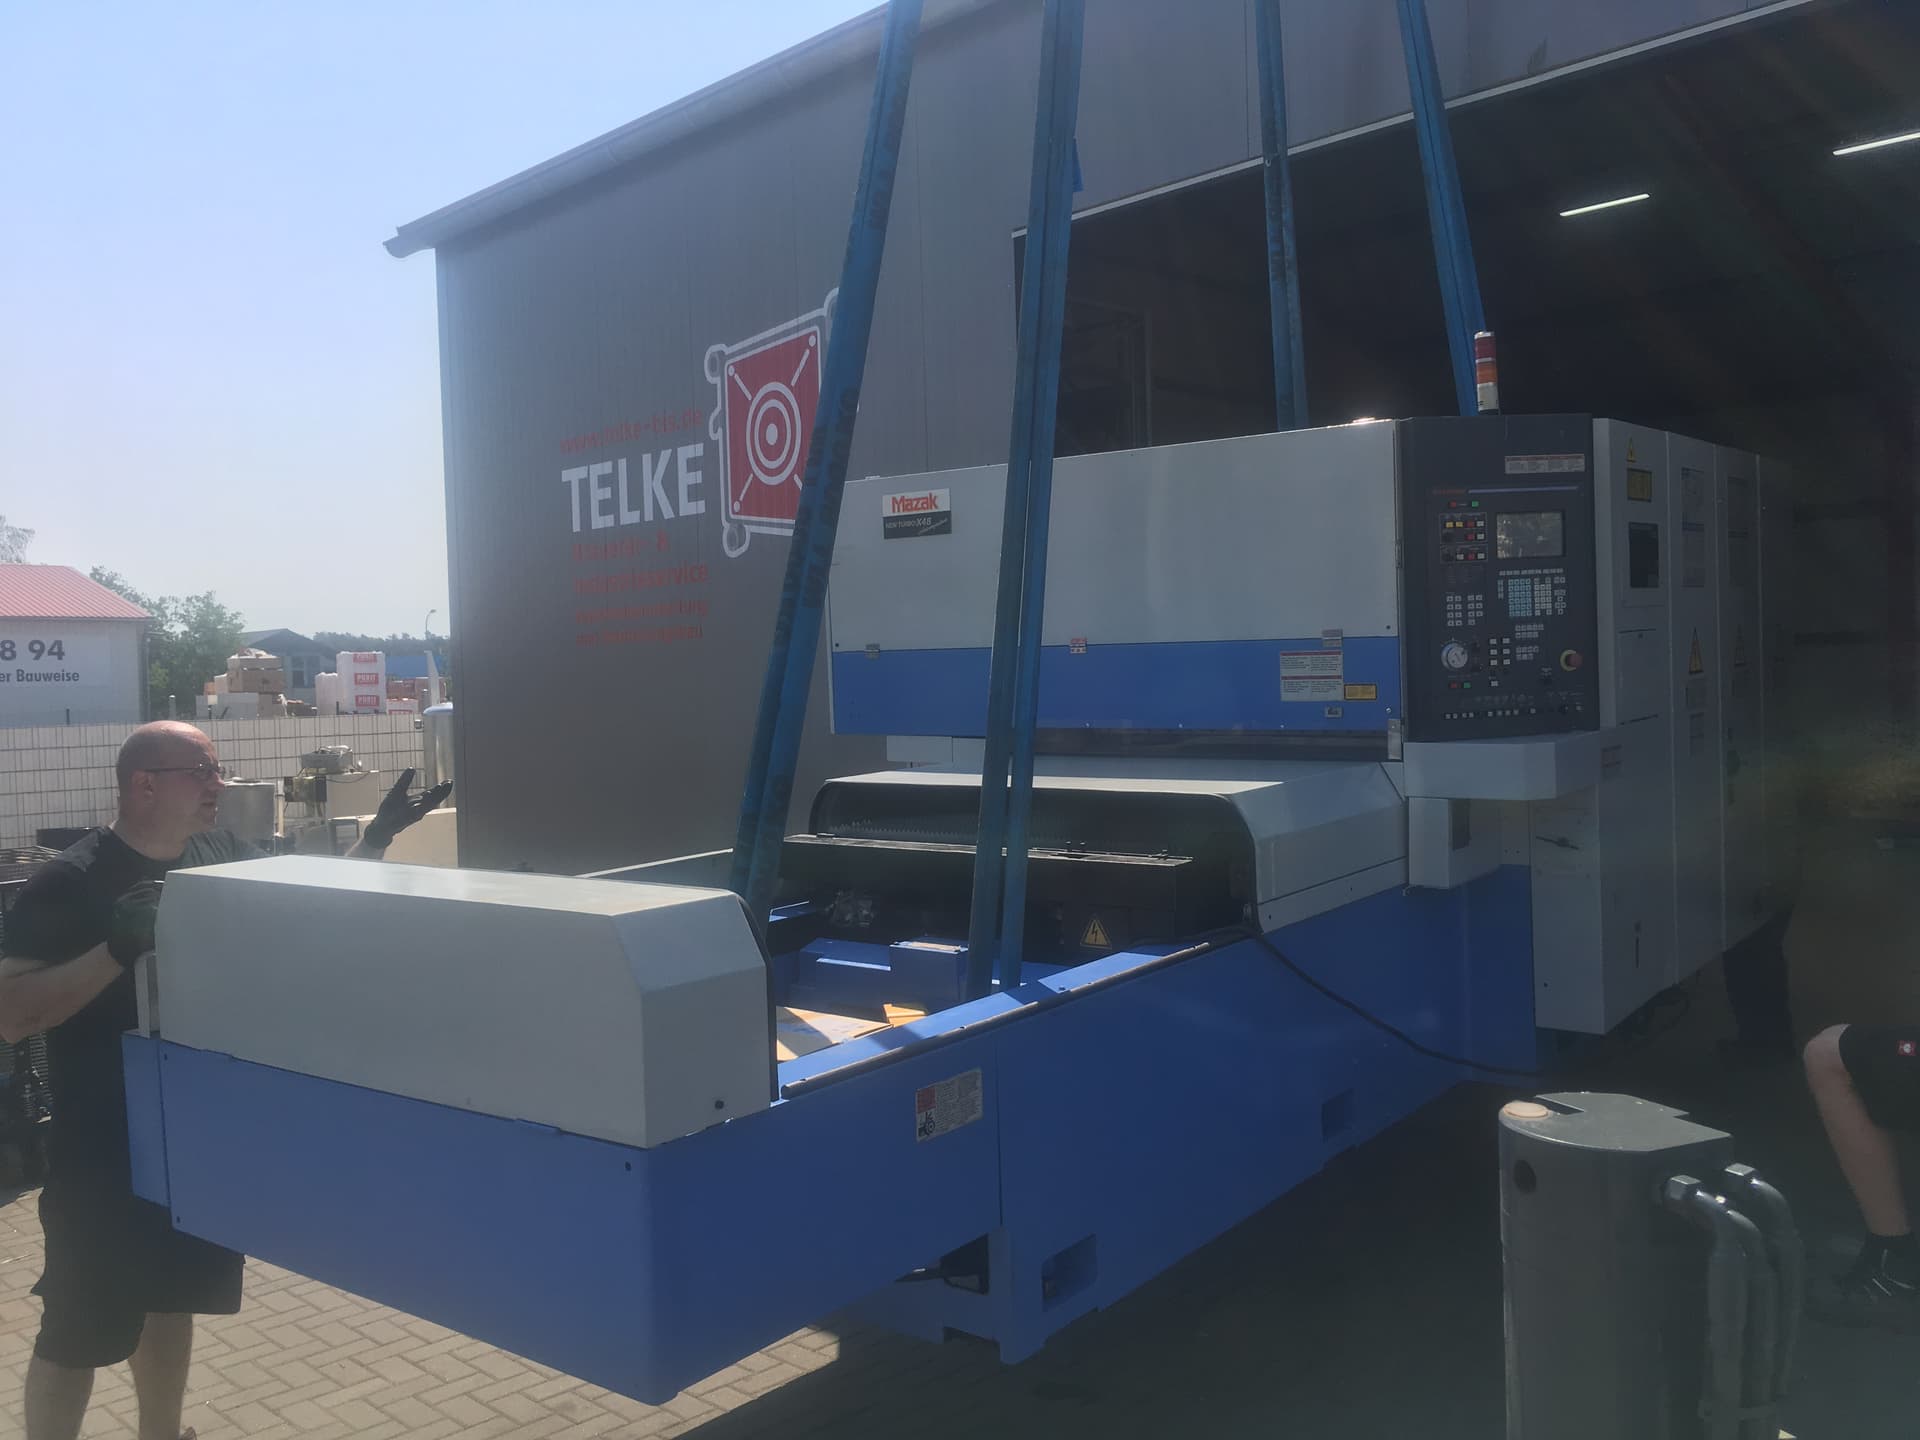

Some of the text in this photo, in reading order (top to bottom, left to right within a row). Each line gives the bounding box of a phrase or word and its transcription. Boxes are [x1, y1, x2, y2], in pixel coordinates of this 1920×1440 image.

[561, 443, 706, 533] TELKE
[891, 492, 938, 513] Mazak
[0, 639, 65, 661] 8 94
[16, 668, 80, 682] Bauweise
